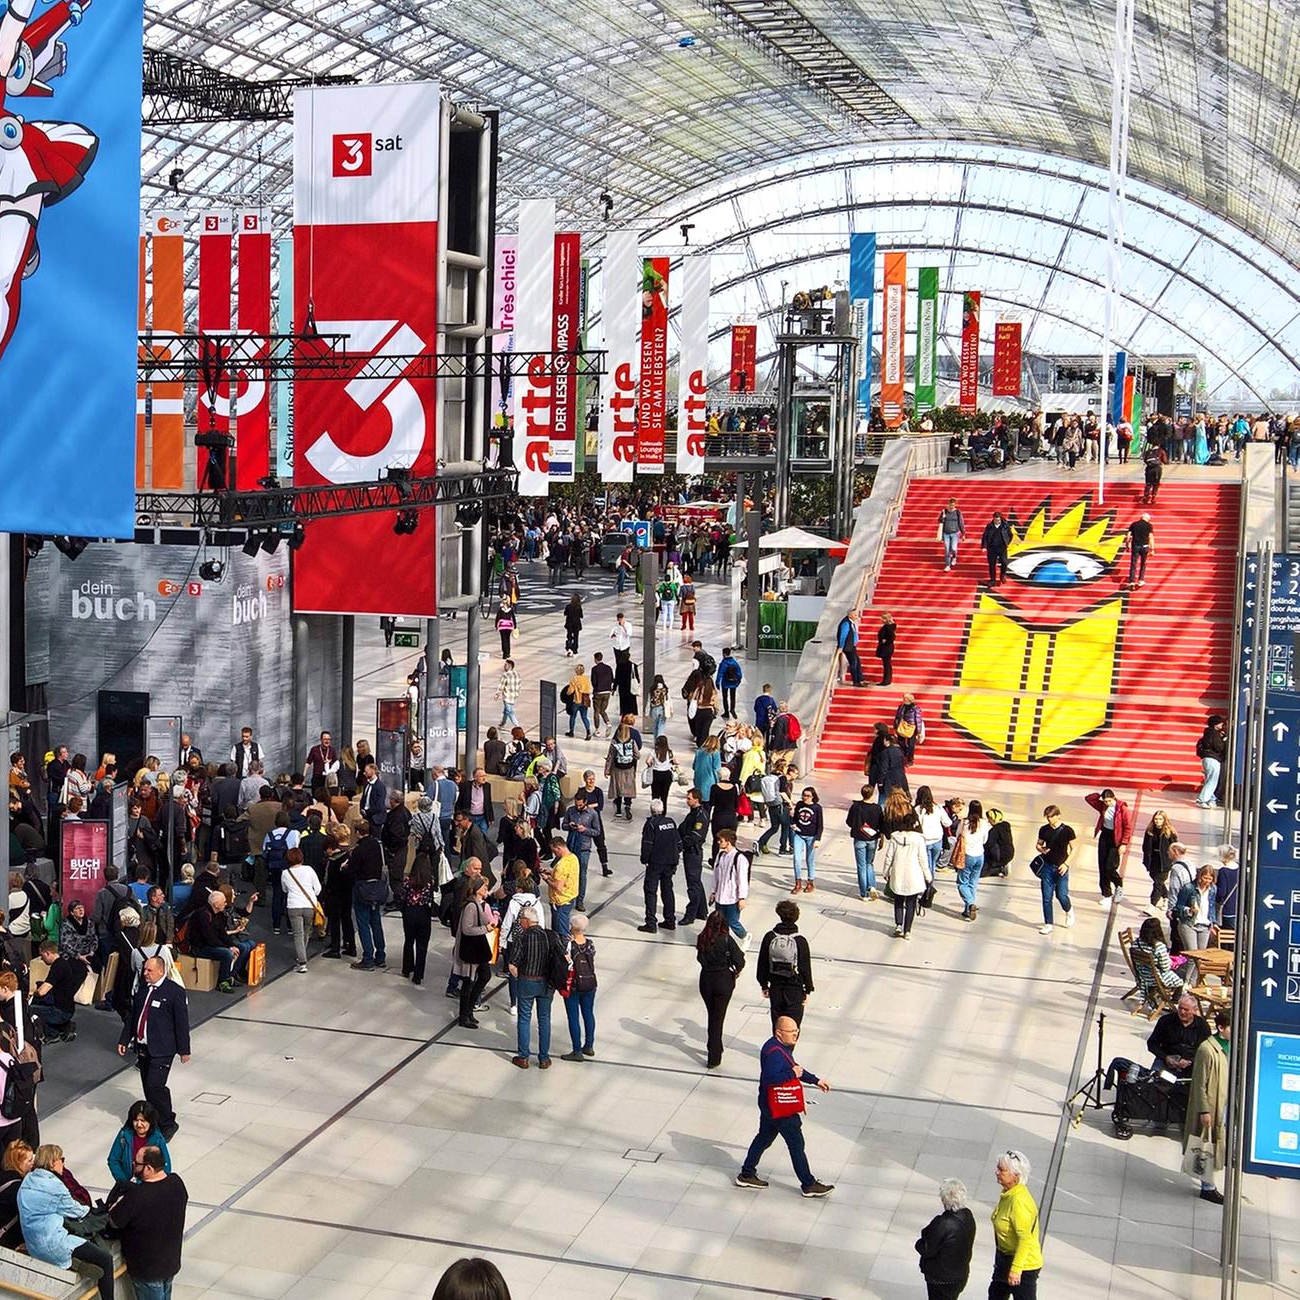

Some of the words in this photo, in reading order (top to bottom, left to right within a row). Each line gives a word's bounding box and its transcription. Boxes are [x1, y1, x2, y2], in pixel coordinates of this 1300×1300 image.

[501, 250, 516, 291] chic!
[500, 294, 514, 328] Très
[643, 341, 653, 375] LESEN
[654, 327, 665, 384] LIEBSTEN?
[889, 314, 898, 381] Deutschlandfunk
[304, 319, 427, 484] 3
[642, 379, 652, 399] WO
[653, 389, 663, 407] AM
[521, 355, 552, 474] arte
[555, 407, 567, 431] DER
[610, 362, 638, 463] arte
[641, 402, 651, 429] UND
[652, 412, 662, 429] SIE
[684, 369, 709, 458] arte
[81, 580, 114, 595] dein
[71, 590, 156, 622] buch
[233, 590, 267, 624] buch
[429, 727, 454, 737] buch
[659, 823, 675, 831] POLIZEI
[69, 867, 101, 880] ZEIT
[70, 859, 101, 868] BUCH
